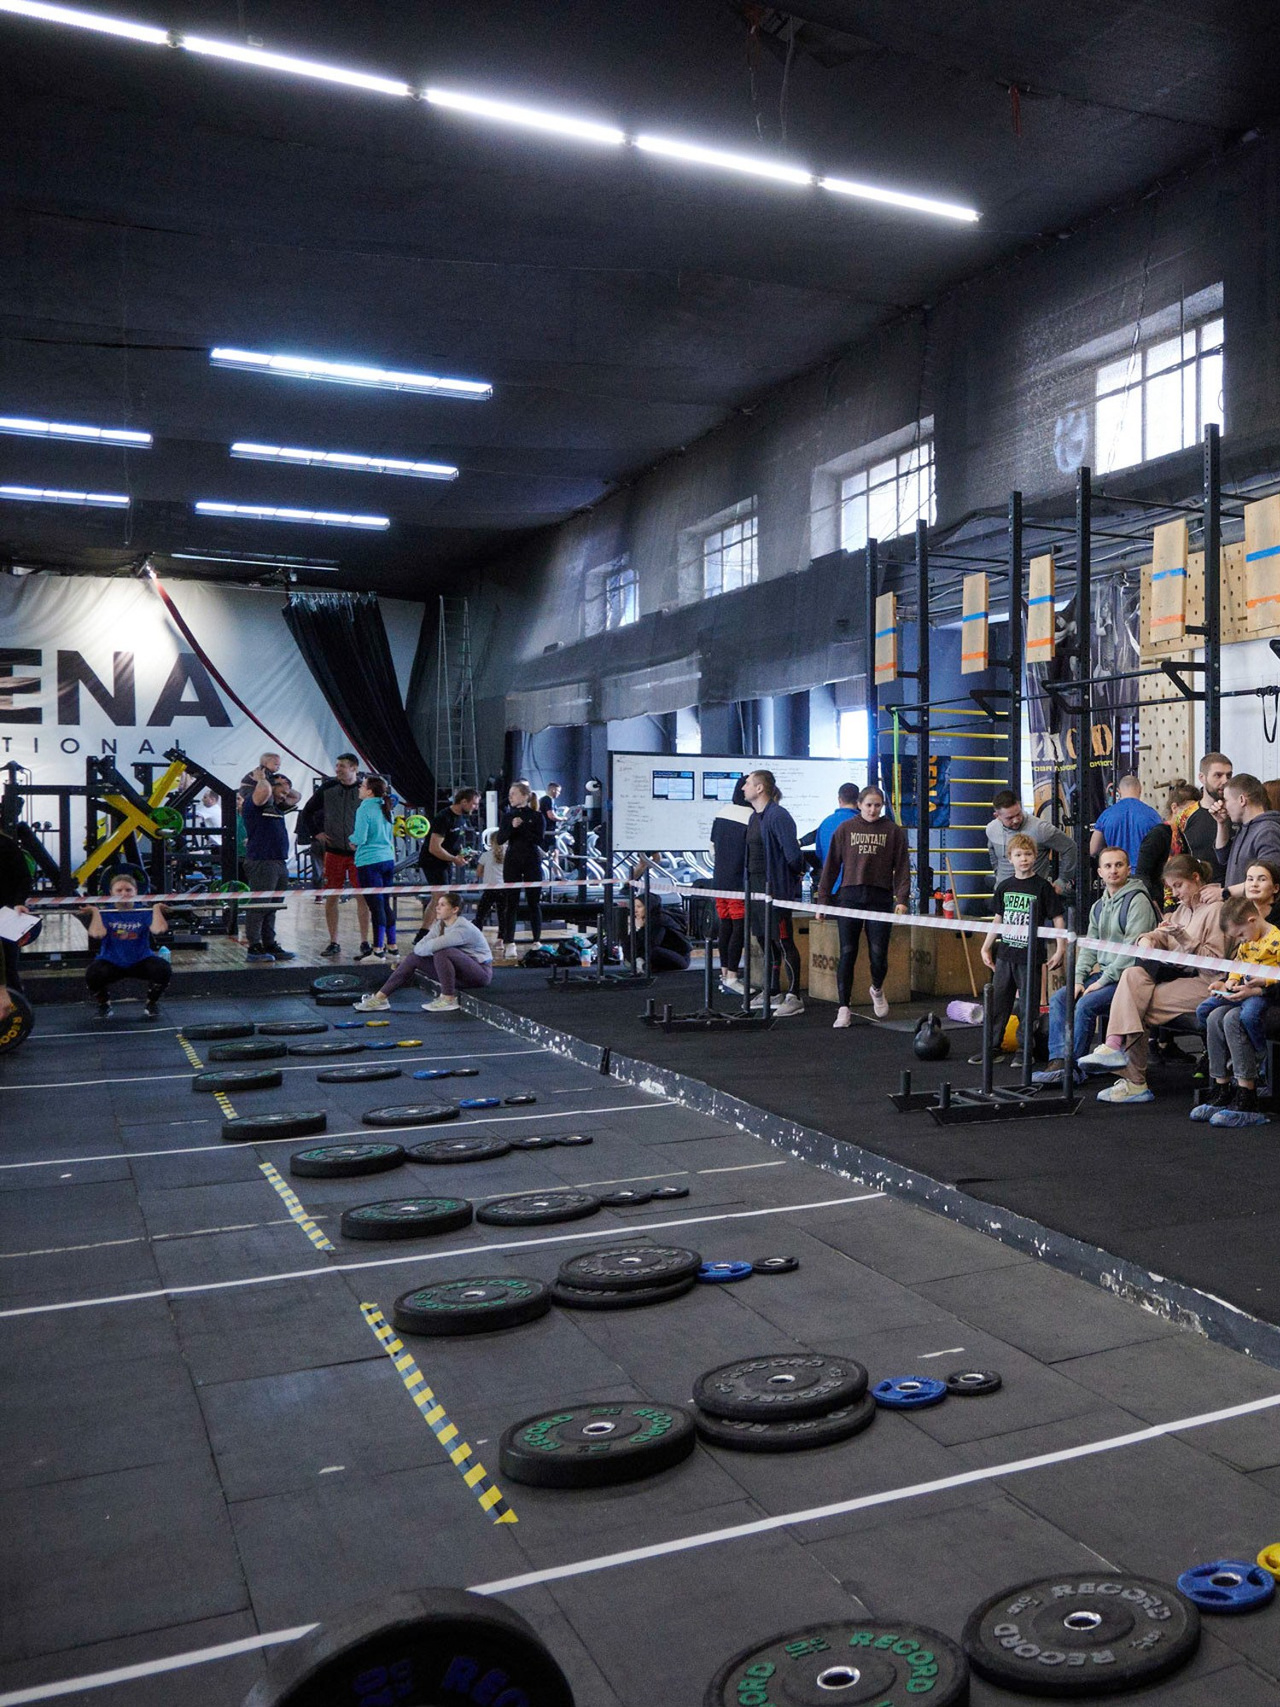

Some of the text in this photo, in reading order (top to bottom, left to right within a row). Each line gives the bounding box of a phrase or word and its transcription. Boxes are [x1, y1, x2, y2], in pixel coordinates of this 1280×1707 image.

[850, 832, 888, 846] MOUNTAIN
[858, 845, 878, 854] PEAK
[1051, 1582, 1172, 1621] RECORD
[849, 1631, 939, 1693] RECORD
[993, 1623, 1117, 1667] RECORD
